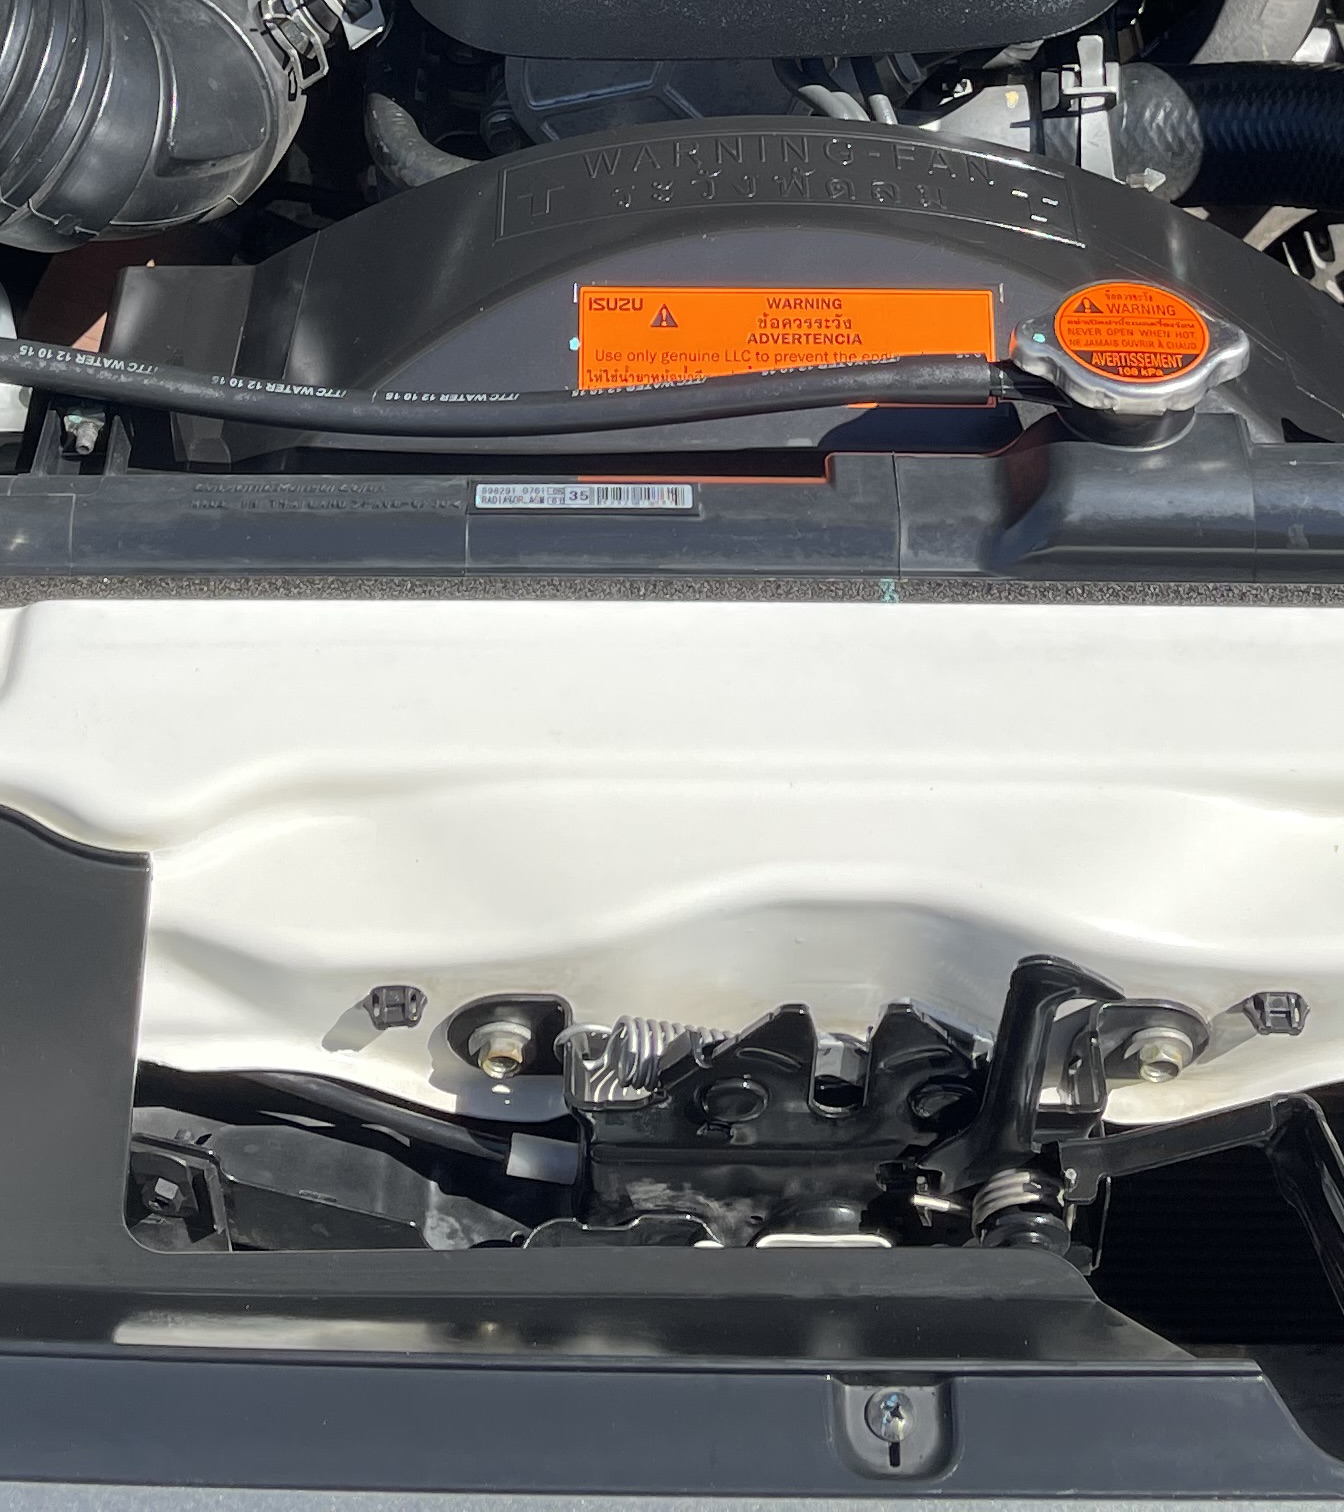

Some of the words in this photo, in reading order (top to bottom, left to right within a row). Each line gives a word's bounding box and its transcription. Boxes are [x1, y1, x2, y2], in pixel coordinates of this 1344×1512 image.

[588, 297, 644, 312] ISUZU
[766, 297, 843, 311] WARNING
[1105, 303, 1176, 316] WARNING
[747, 332, 863, 345] ADVERTENCIA
[1067, 328, 1102, 337] NEVER
[1106, 328, 1134, 337] OPEN
[1139, 329, 1171, 338] WHEN
[18, 344, 34, 357] 15
[38, 347, 53, 359] 10
[57, 350, 72, 362] 12
[75, 353, 125, 371] WATER
[594, 349, 622, 362] Use
[626, 349, 659, 365] only
[661, 350, 721, 365] genuine
[725, 349, 752, 362] LLC
[755, 350, 770, 364] to
[774, 350, 828, 366] prevent
[1091, 352, 1183, 368] AVERTISSEMENT
[127, 361, 159, 374] ITTC
[229, 377, 244, 388] 10
[247, 379, 262, 390] 12
[265, 382, 314, 395] WATER
[315, 386, 347, 398] ITTC
[439, 392, 487, 402] WATER
[488, 392, 520, 401] ITTC
[568, 489, 589, 501] 35
